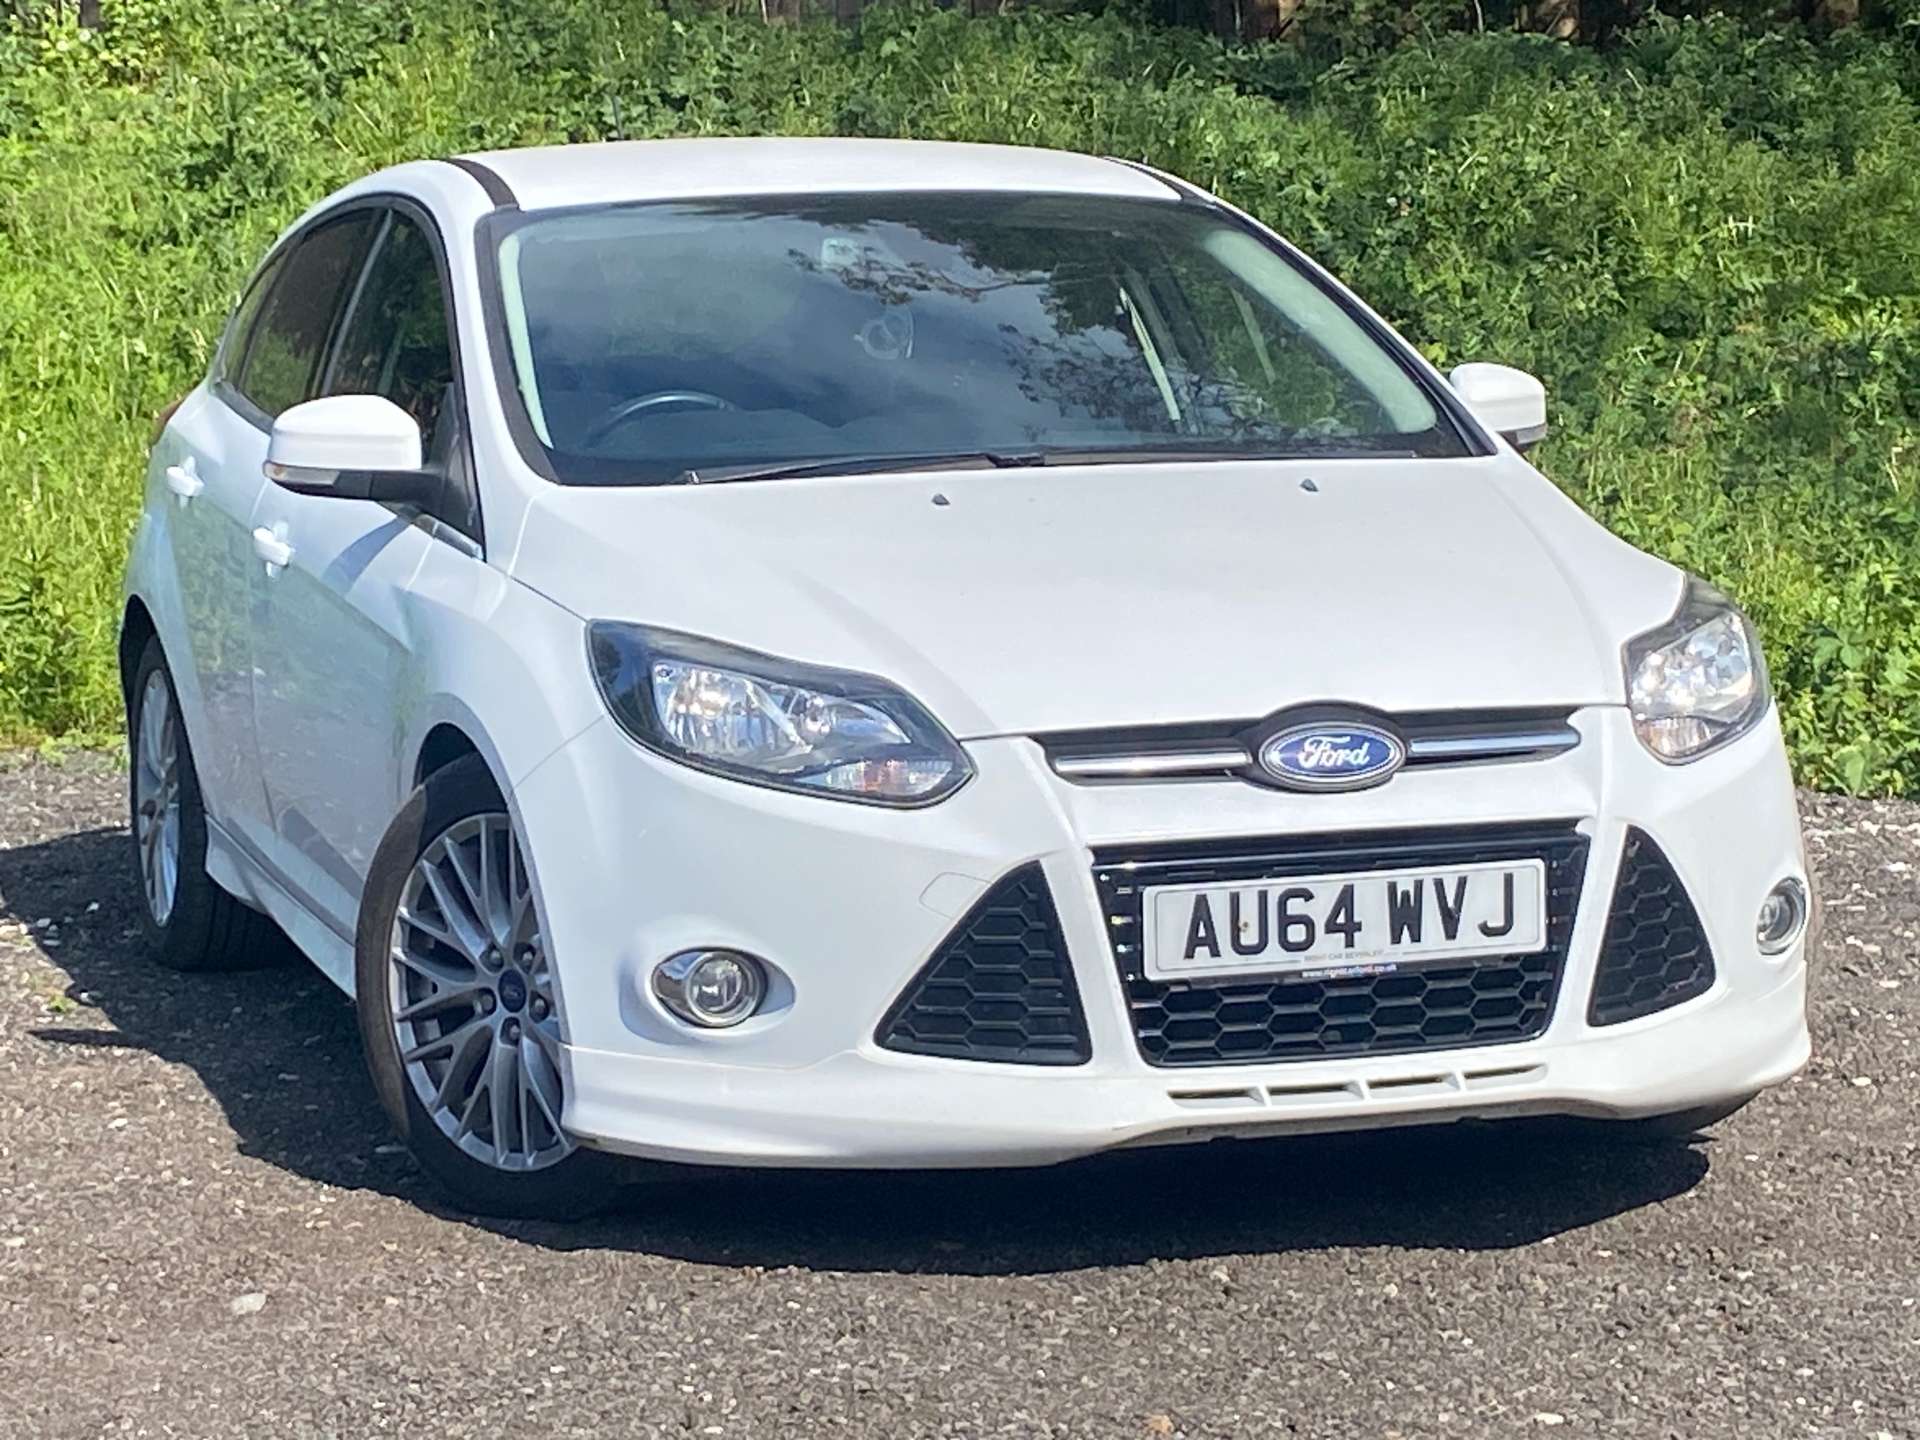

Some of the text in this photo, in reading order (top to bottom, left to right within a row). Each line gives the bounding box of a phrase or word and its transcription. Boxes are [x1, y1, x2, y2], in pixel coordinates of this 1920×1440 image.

[1297, 736, 1370, 768] Ford
[1183, 871, 1514, 960] AU64 WVJ
